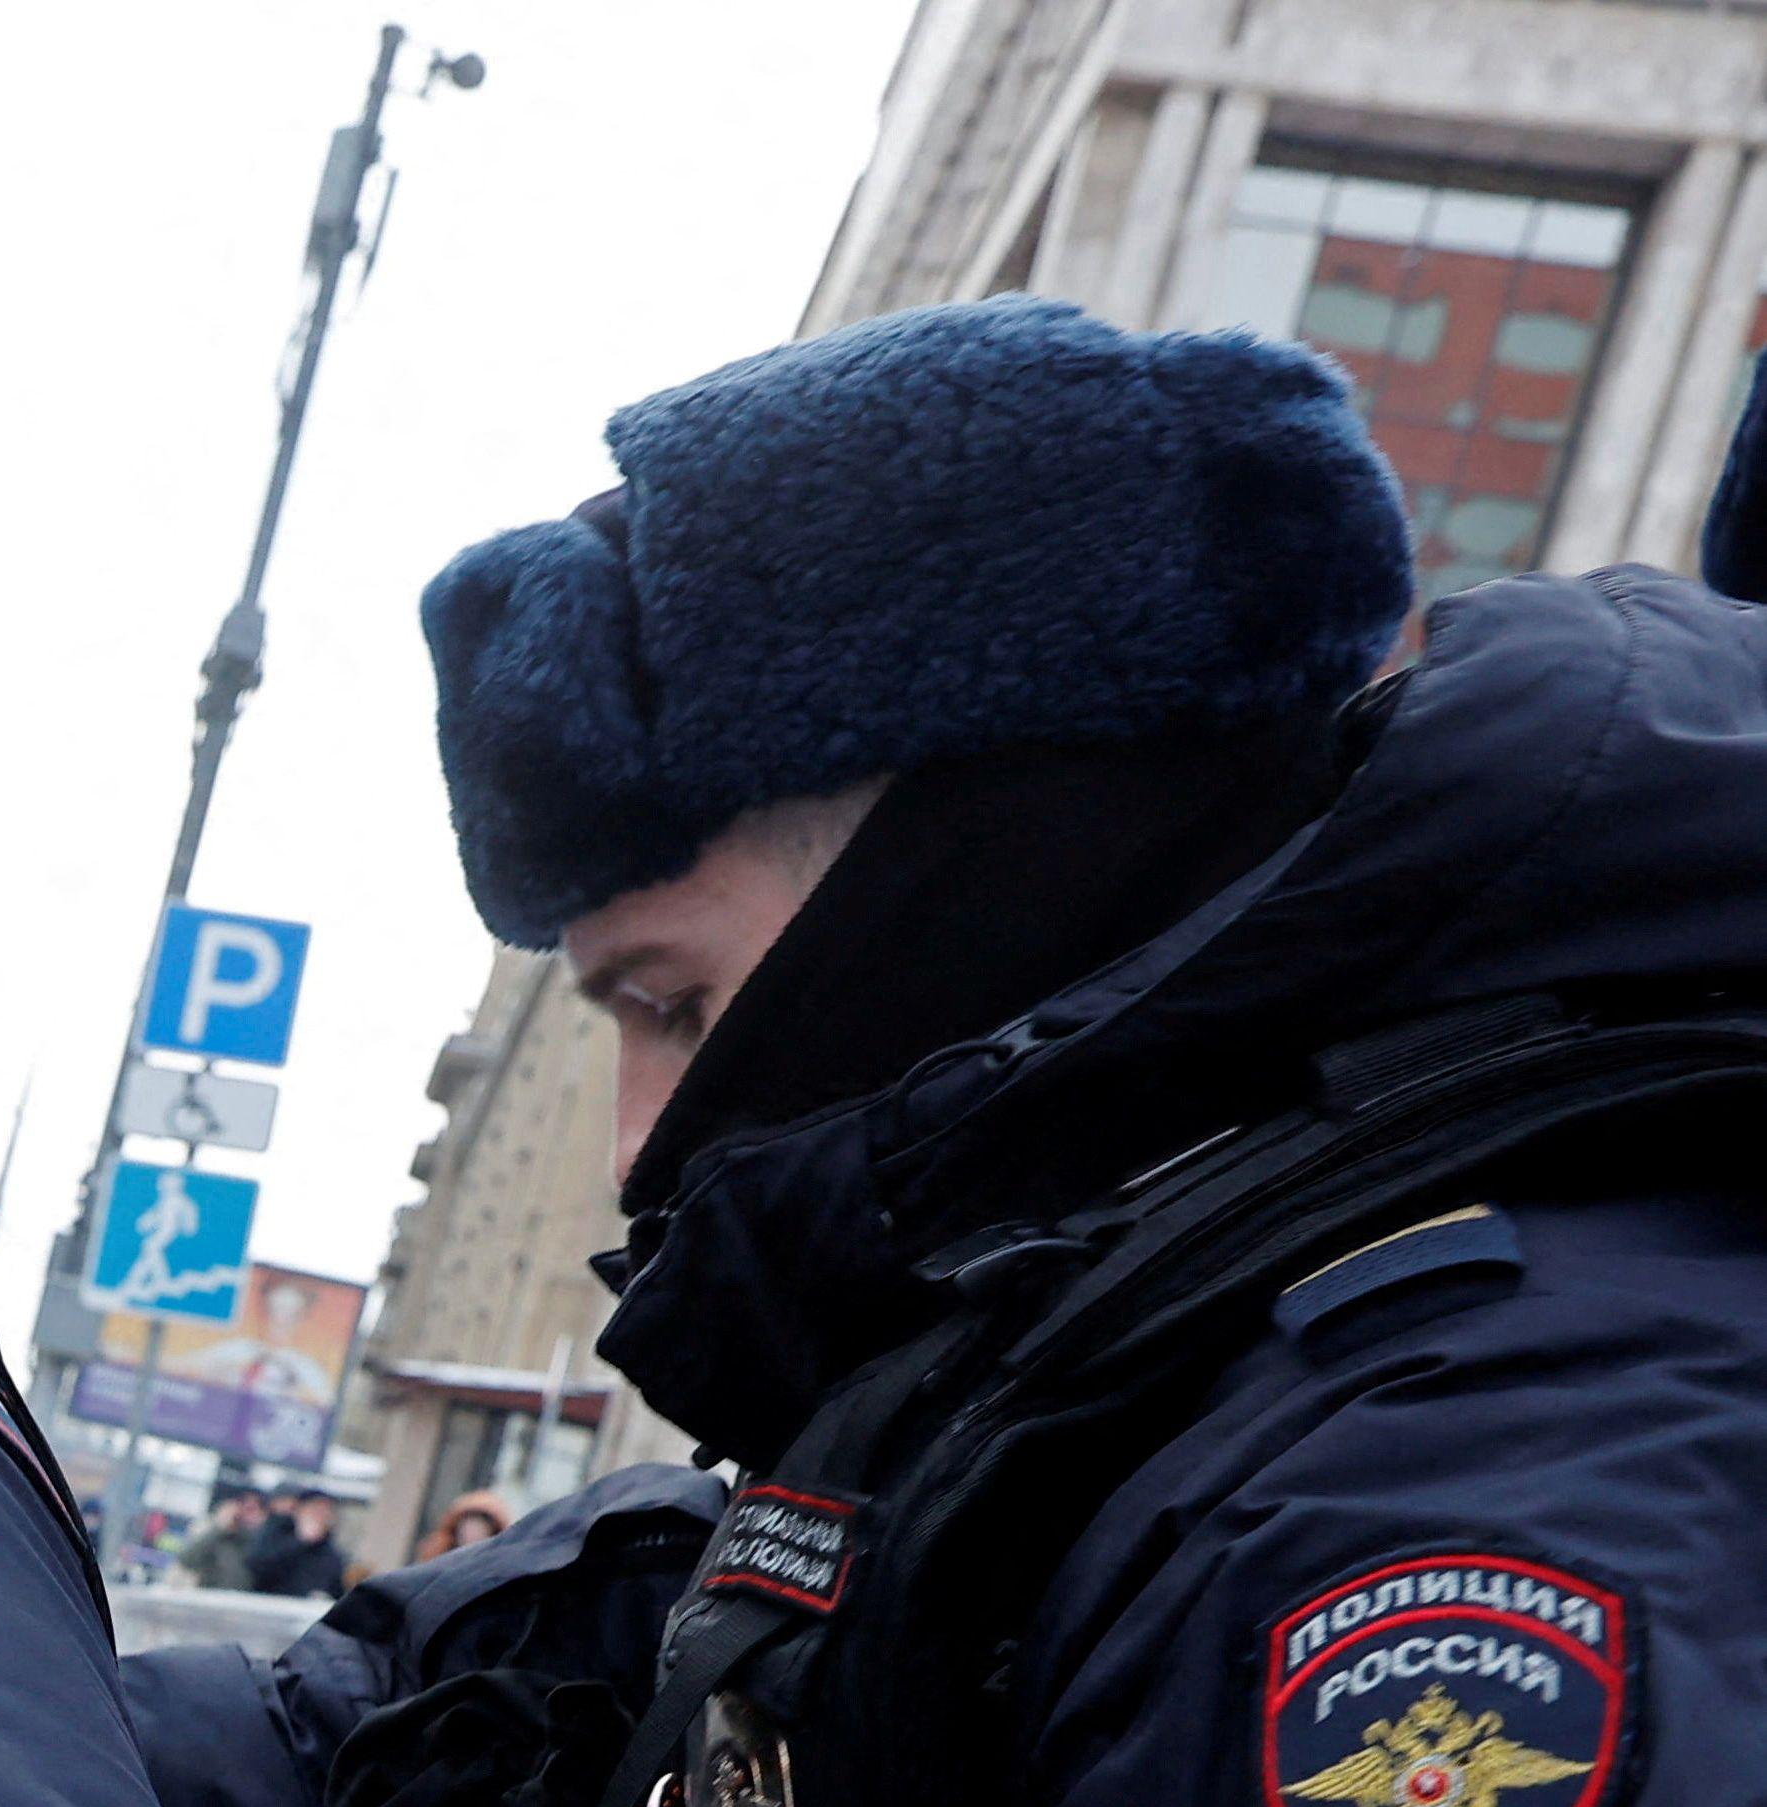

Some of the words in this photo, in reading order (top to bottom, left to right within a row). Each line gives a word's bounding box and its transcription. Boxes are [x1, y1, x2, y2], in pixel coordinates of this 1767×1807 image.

[180, 920, 283, 1043] P
[1286, 1568, 1606, 1671] ПОЛИЦИЯ
[1314, 1633, 1563, 1723] РОССИЯ
